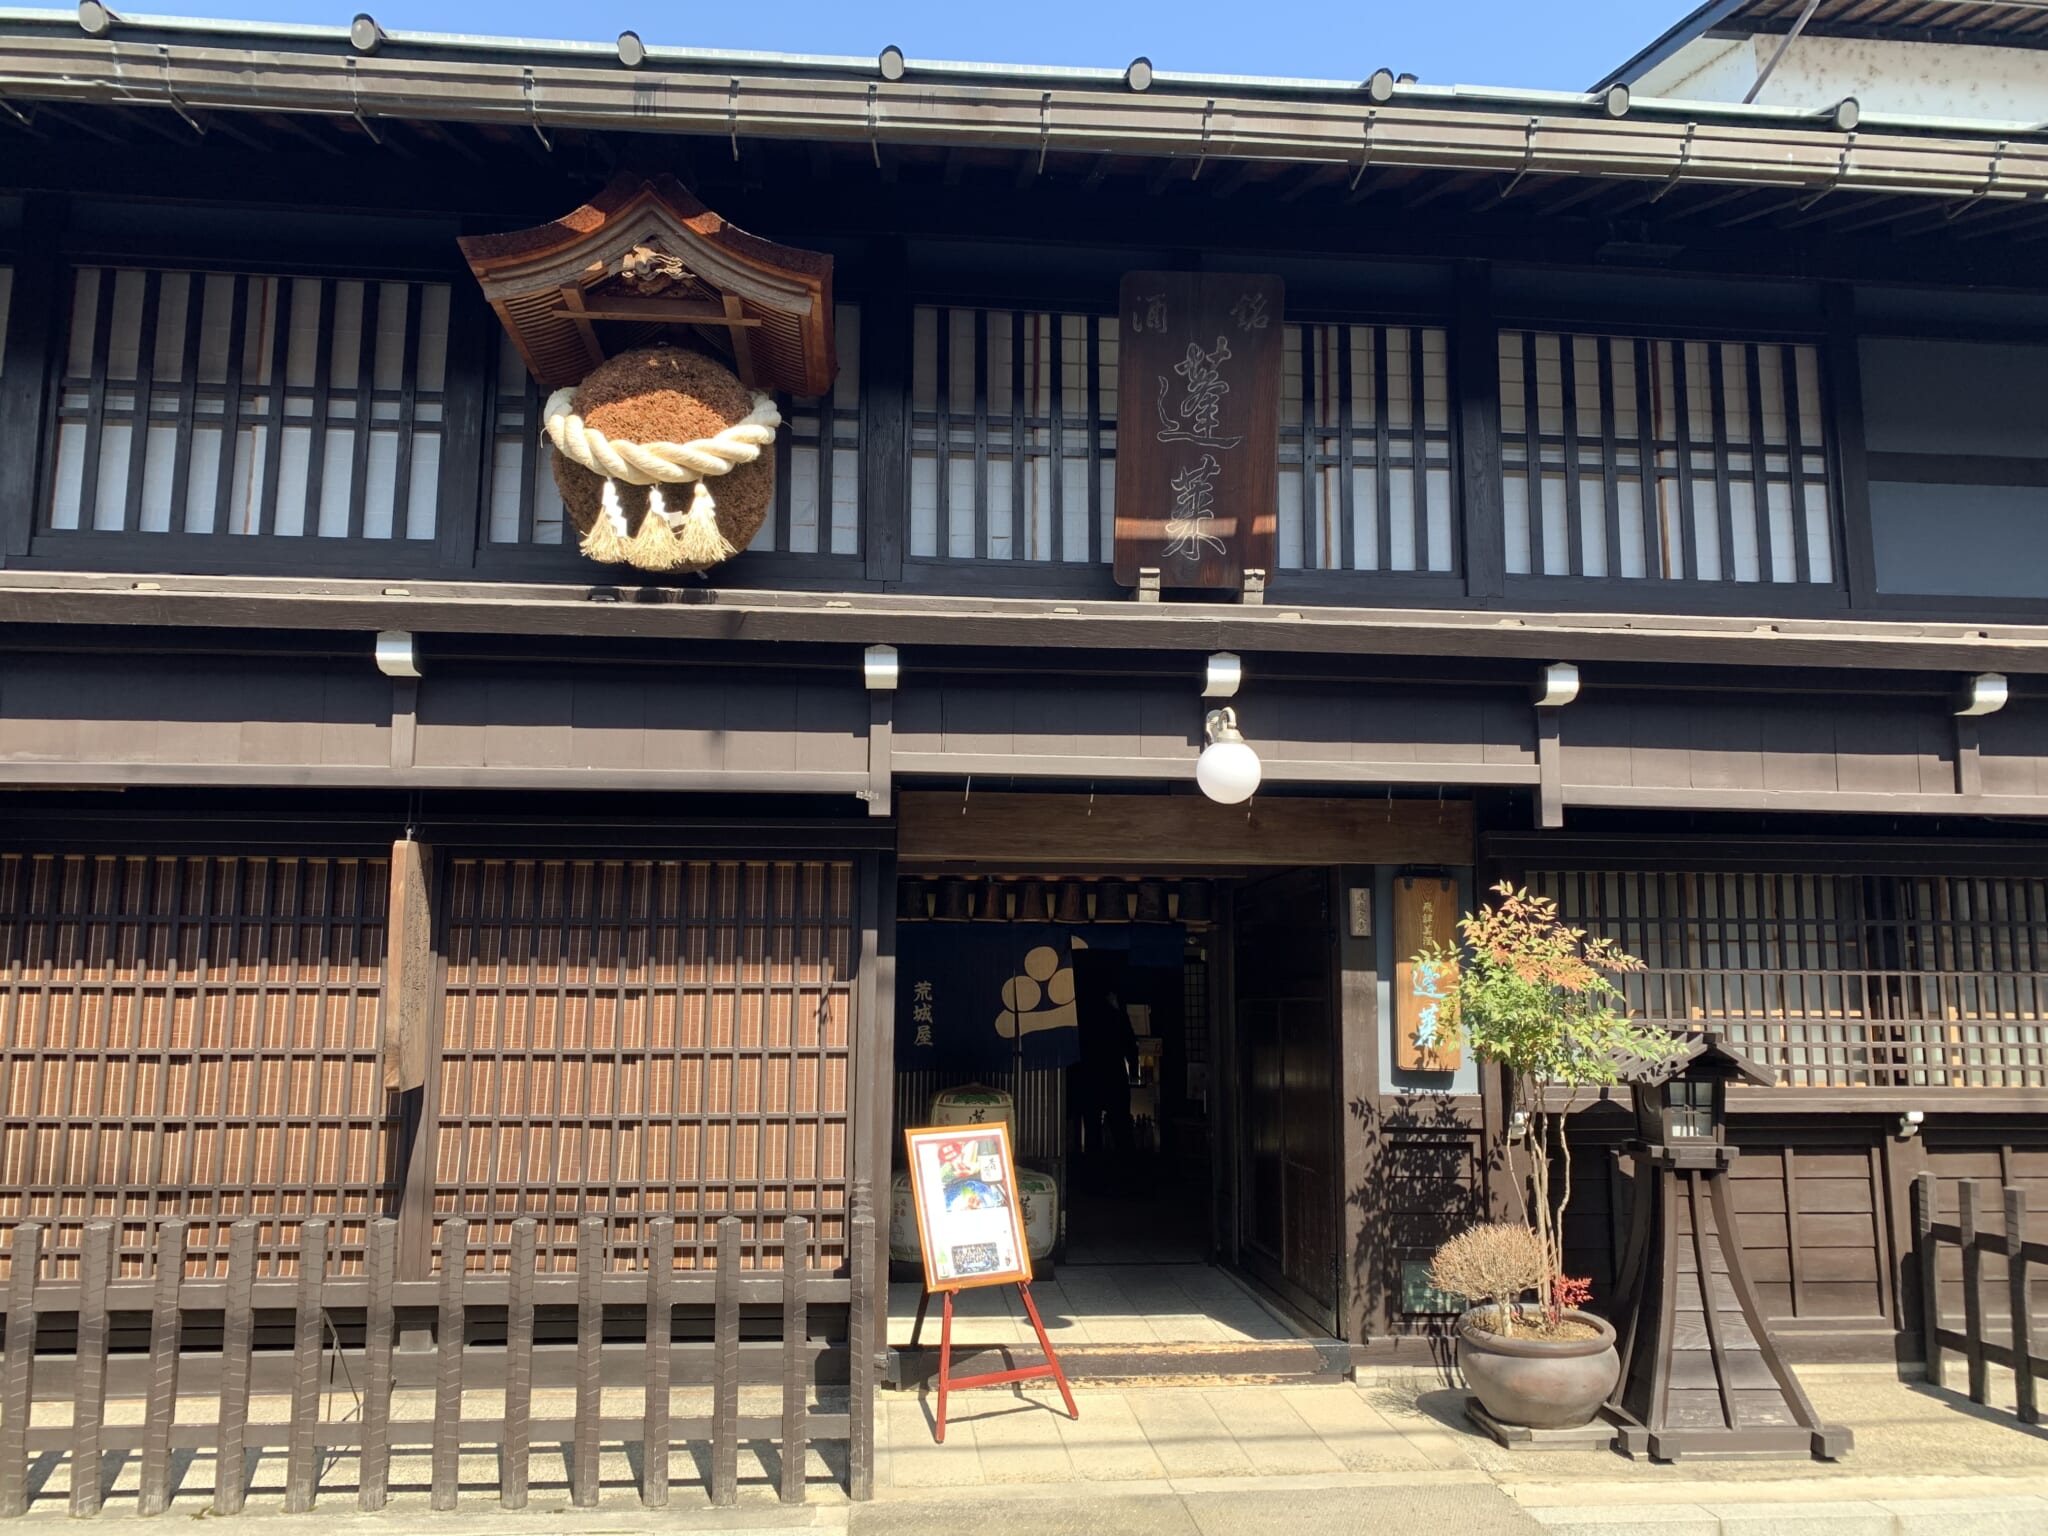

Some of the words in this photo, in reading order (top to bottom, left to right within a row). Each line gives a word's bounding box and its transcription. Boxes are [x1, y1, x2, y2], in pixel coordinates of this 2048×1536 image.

[1157, 335, 1244, 561] 蓬莱
[913, 981, 934, 1047] 荒城屋
